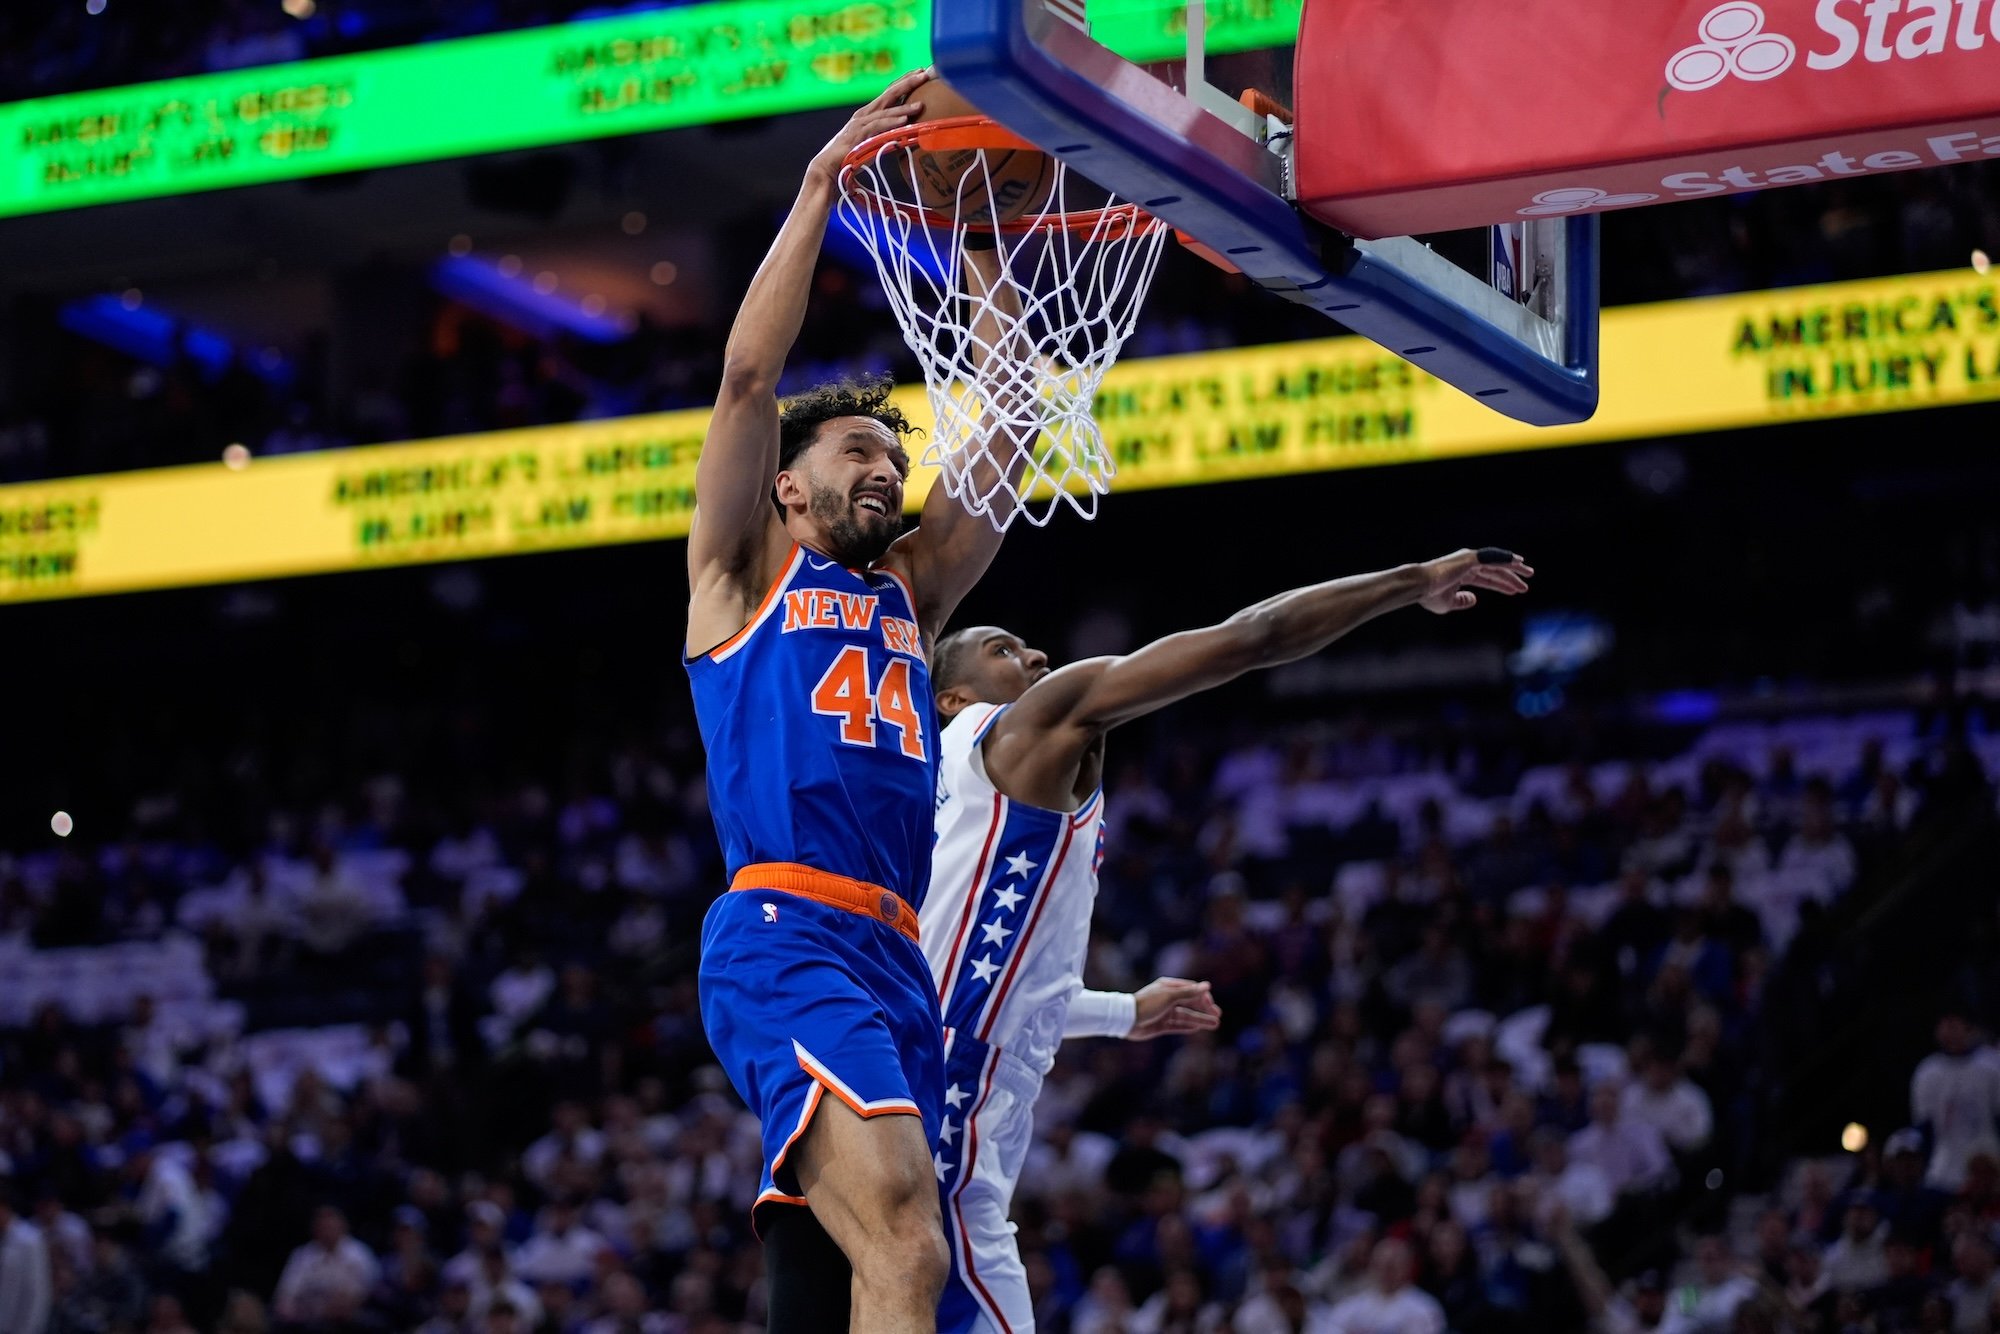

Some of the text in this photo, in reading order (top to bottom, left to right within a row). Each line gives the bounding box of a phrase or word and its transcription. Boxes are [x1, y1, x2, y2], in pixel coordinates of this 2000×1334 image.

[1806, 0, 2000, 70] Stat
[1661, 132, 2000, 196] State F
[1735, 290, 2000, 353] AMERICA'S
[1767, 350, 1944, 399] INJURY
[781, 588, 927, 666] NEW RK
[811, 644, 927, 763] 44
